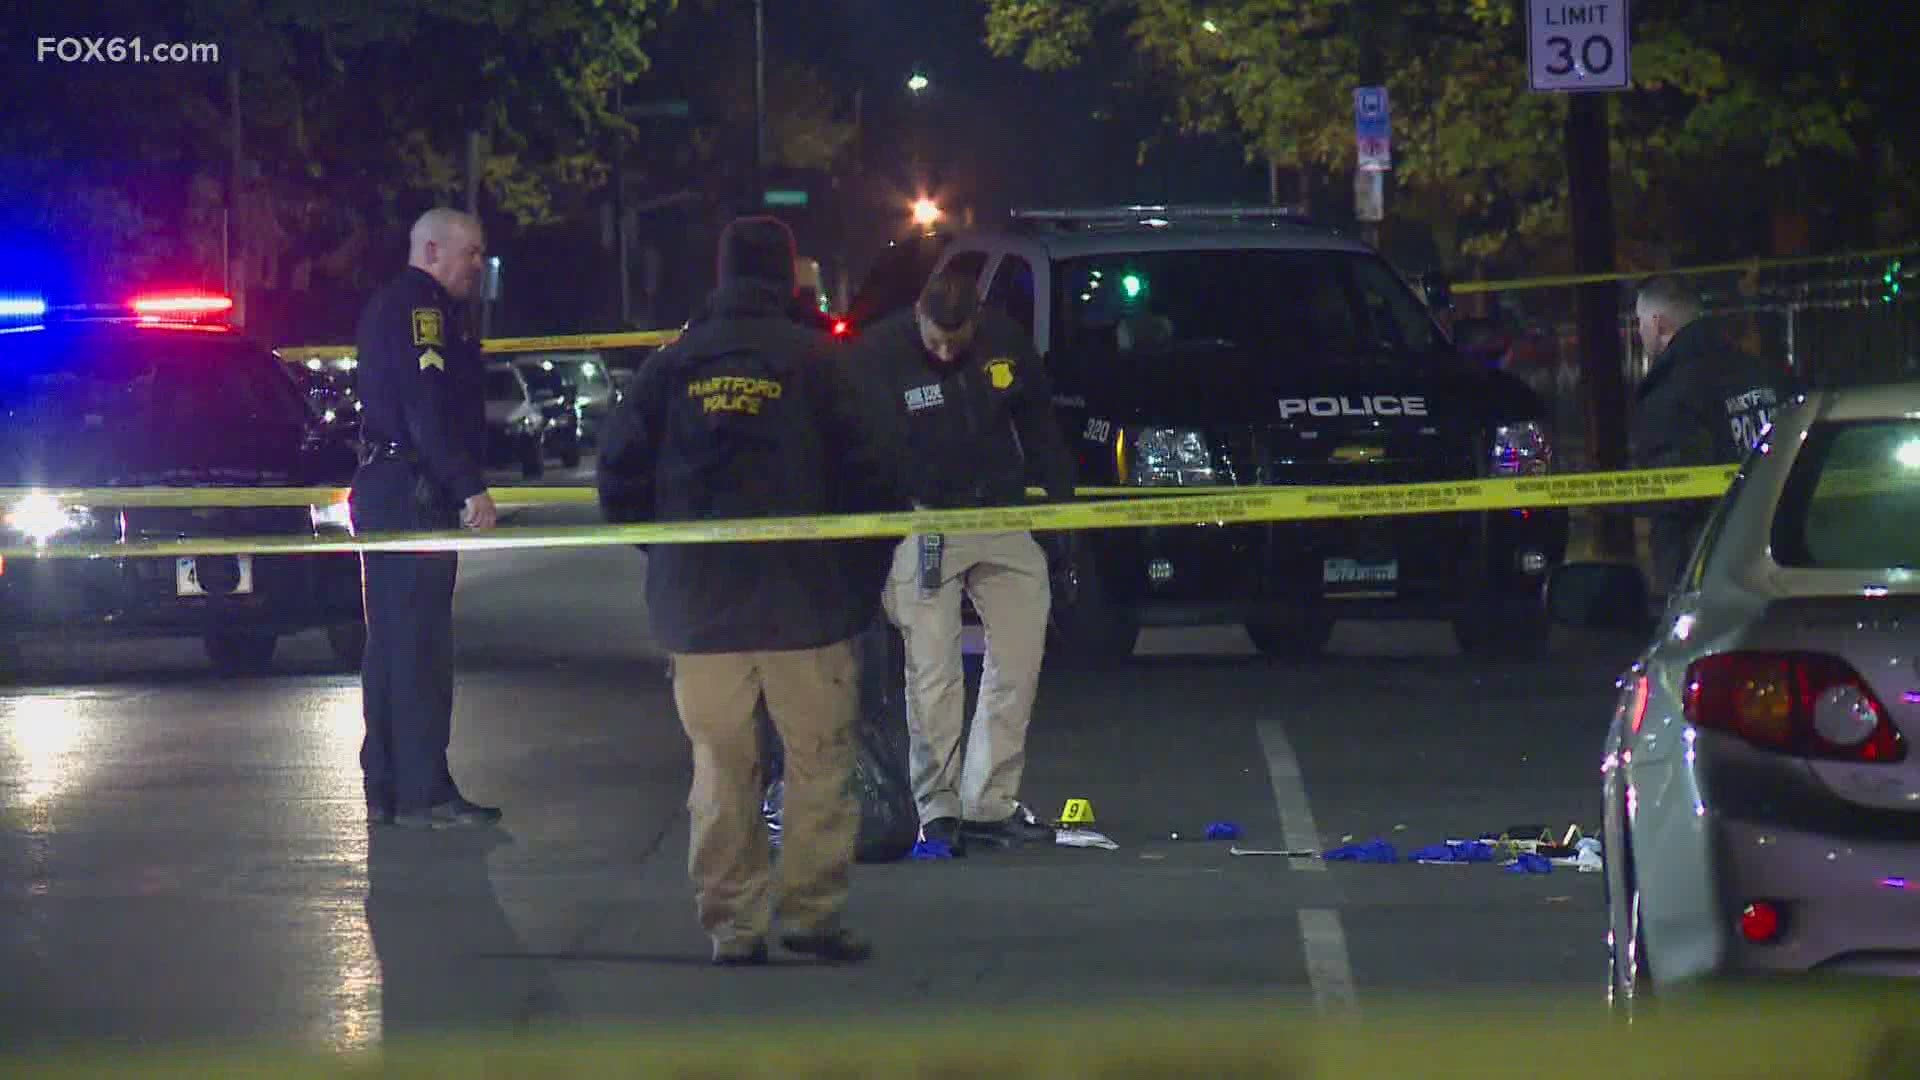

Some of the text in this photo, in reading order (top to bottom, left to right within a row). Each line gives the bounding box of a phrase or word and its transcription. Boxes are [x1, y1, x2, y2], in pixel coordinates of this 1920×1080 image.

[1546, 4, 1608, 25] LIMIT
[1546, 34, 1613, 74] 30
[687, 376, 782, 399] HARTFORD
[703, 395, 761, 415] POLICE
[1278, 395, 1429, 419] POLICE
[1083, 417, 1110, 443] 320
[1068, 803, 1079, 818] 9
